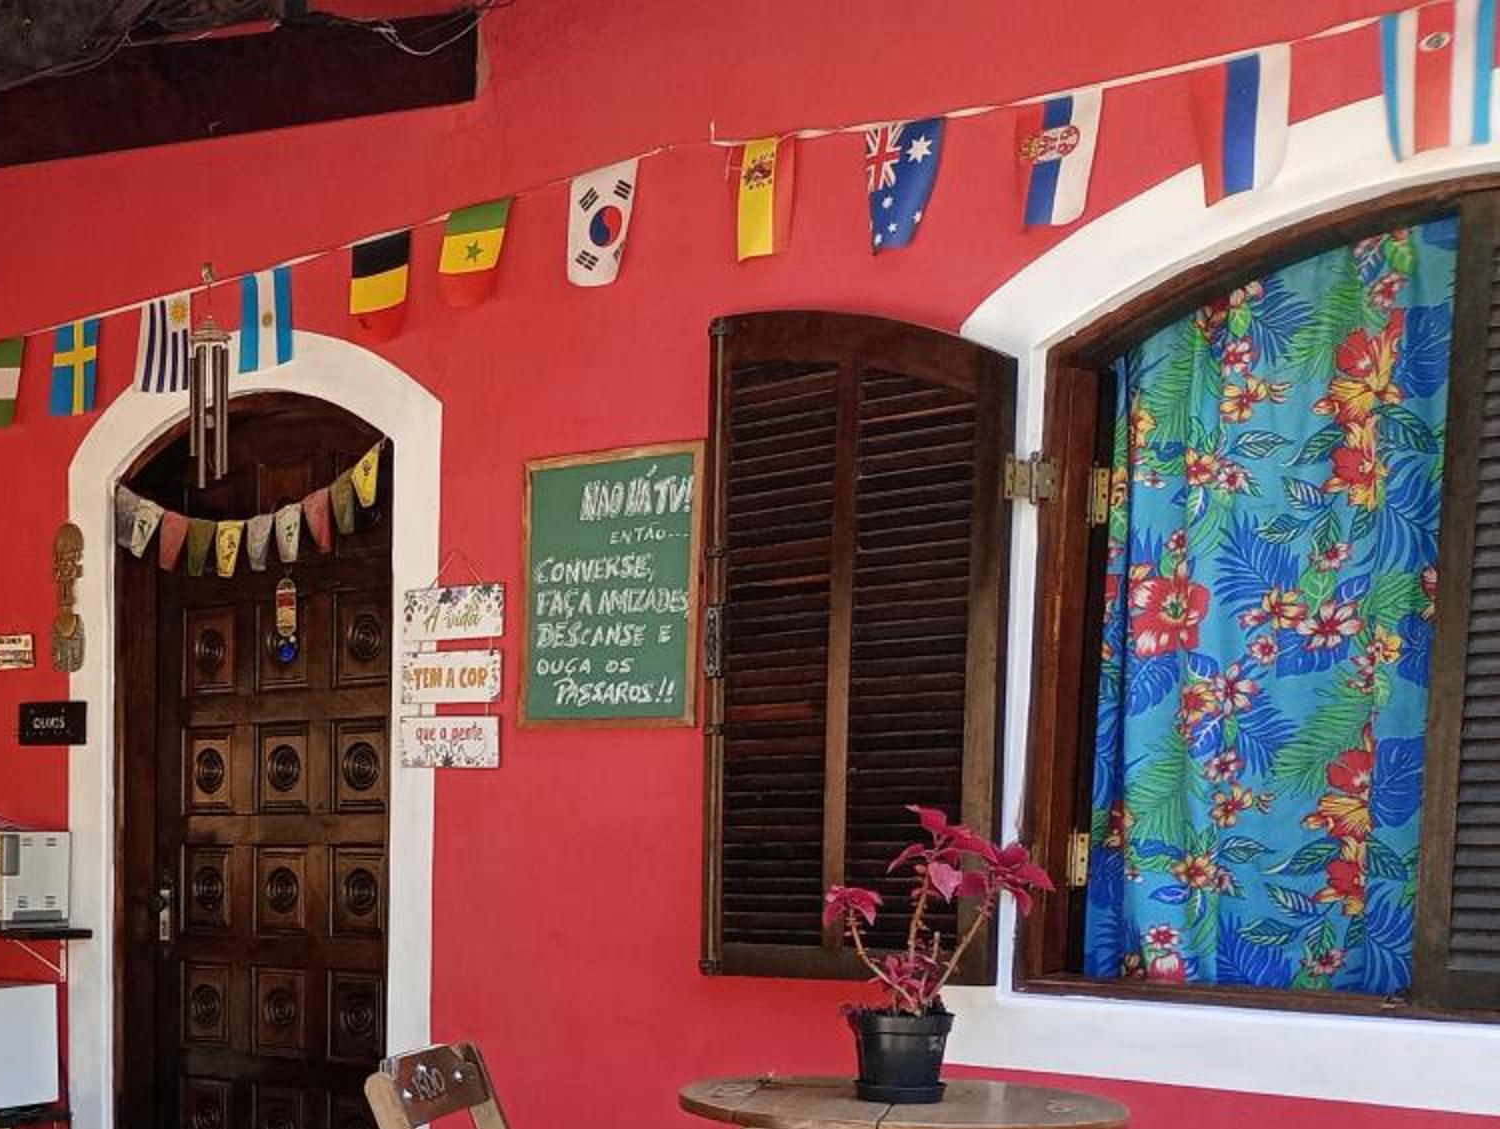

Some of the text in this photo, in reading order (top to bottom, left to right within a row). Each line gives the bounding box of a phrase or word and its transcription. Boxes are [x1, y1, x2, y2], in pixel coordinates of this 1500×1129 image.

[536, 621, 673, 649] DESCANSE E
[605, 657, 635, 674] OS
[413, 667, 488, 691] TEM A COR
[415, 727, 437, 746] que
[439, 727, 447, 740] a
